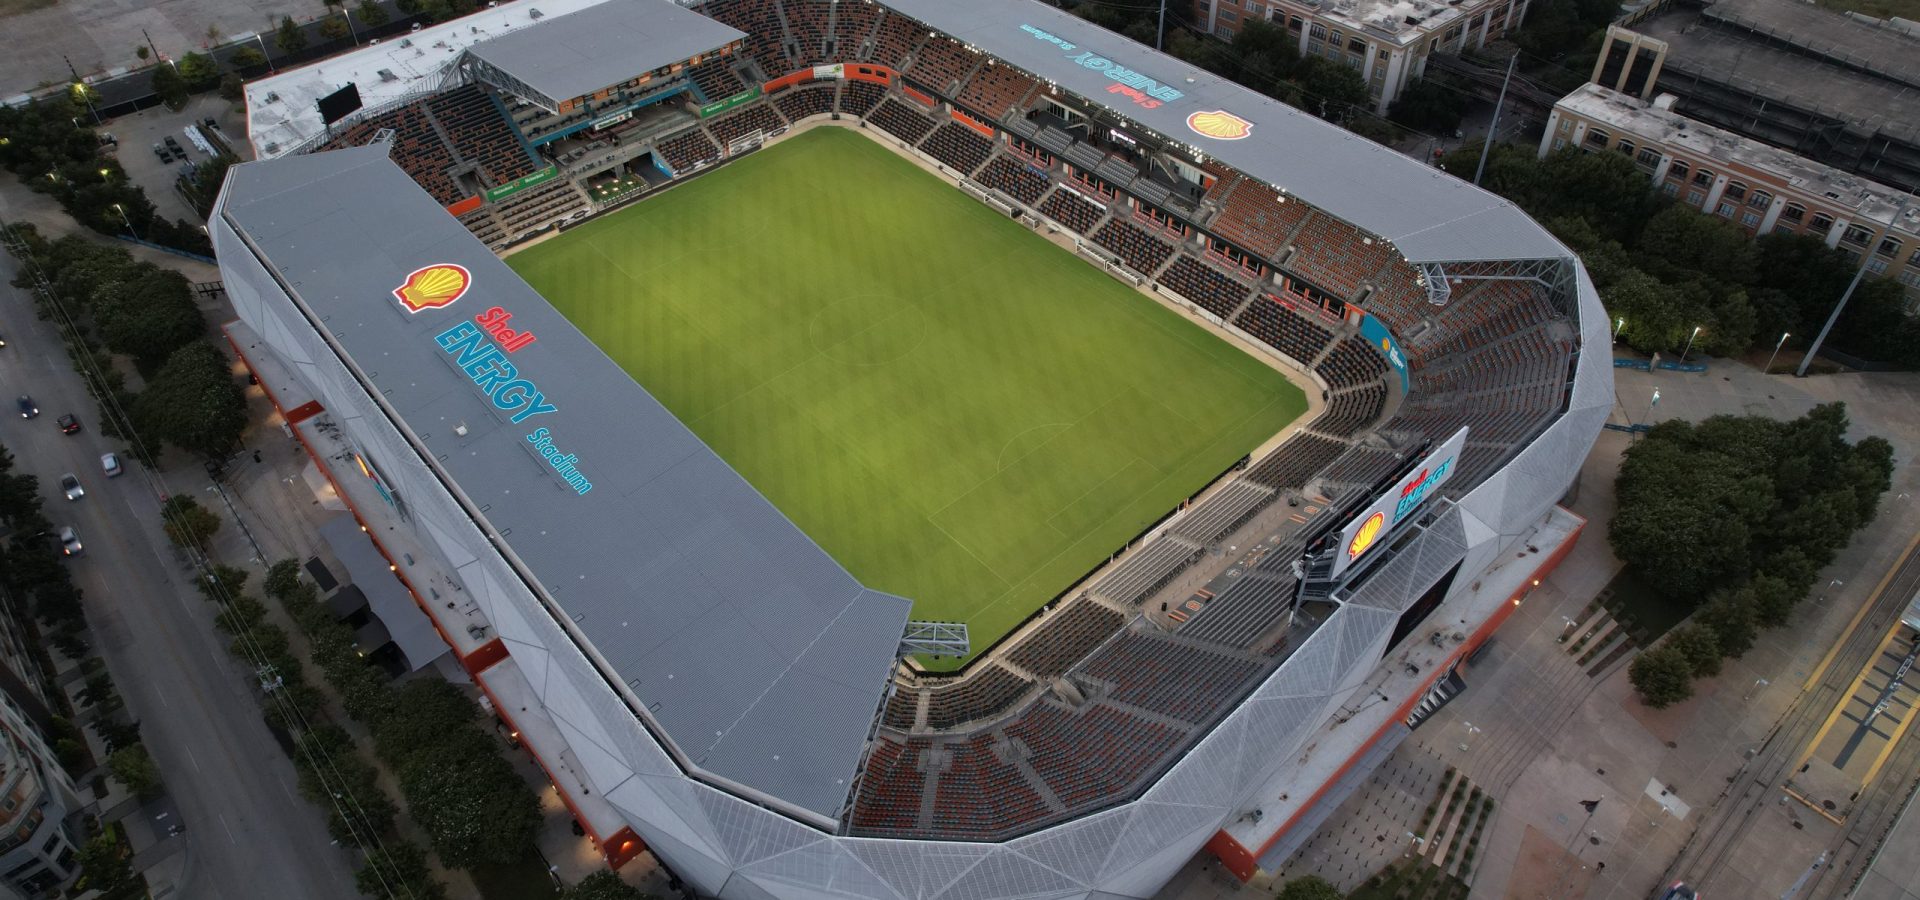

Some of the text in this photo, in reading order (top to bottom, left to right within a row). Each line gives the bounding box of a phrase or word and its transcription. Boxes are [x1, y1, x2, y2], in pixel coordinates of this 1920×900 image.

[1019, 23, 1077, 51] Stadium
[1064, 51, 1186, 103] ENERGY
[1105, 82, 1164, 110] Shell
[475, 306, 537, 354] Shell
[434, 320, 558, 424] ENERGY
[526, 427, 593, 496] Stadium
[1395, 455, 1454, 517] ENERGY
[1400, 468, 1429, 499] Shell
